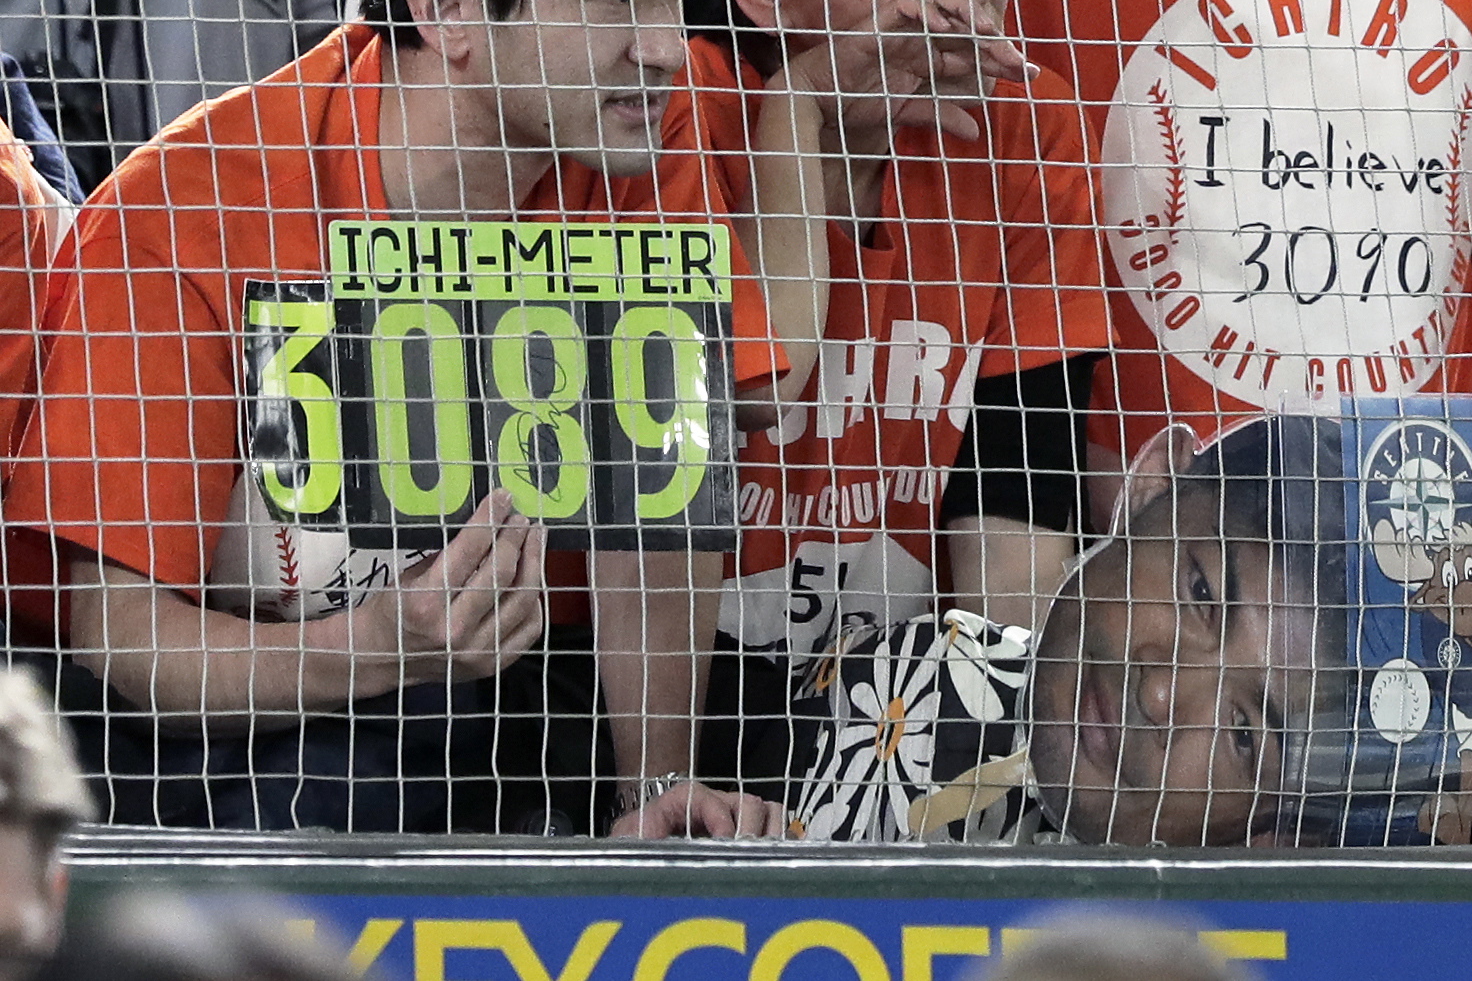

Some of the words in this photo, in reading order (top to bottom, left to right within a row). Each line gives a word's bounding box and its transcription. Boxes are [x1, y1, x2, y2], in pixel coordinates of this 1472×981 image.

[1193, 116, 1231, 188] I
[1261, 119, 1446, 196] believe
[338, 227, 723, 295] ICHI-METER
[1119, 214, 1201, 331] 3000
[1204, 324, 1282, 391] HIT
[1232, 222, 1434, 305] 3090
[248, 300, 710, 520] 3089
